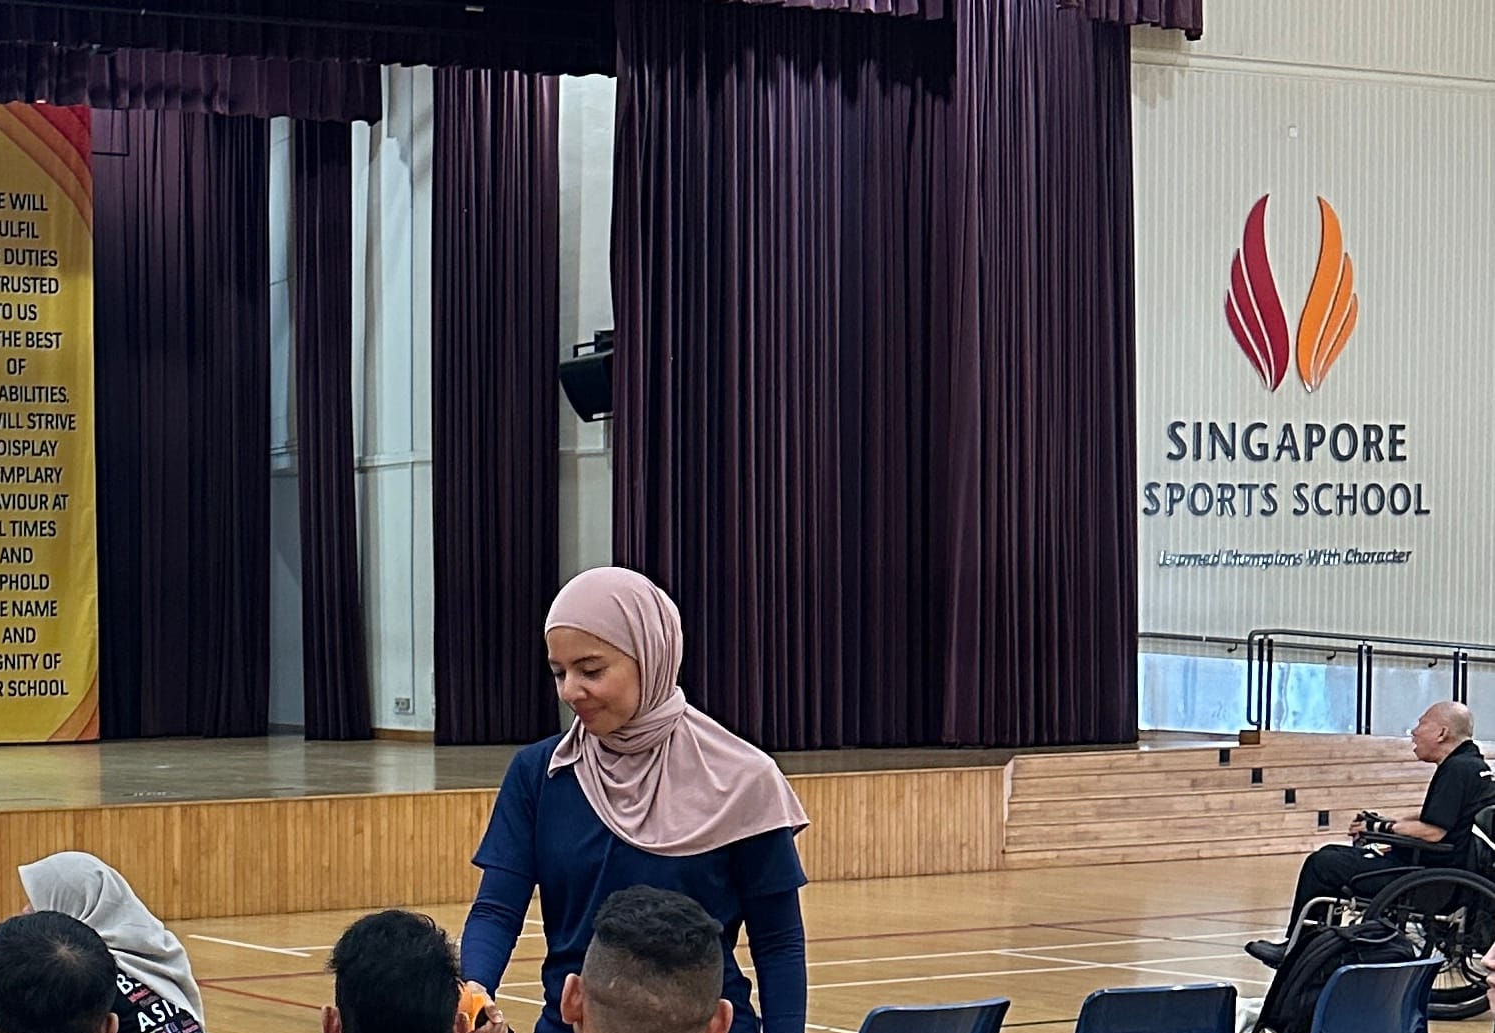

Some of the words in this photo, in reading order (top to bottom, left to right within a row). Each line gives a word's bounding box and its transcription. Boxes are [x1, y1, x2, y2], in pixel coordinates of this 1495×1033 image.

[9, 192, 48, 212] WILL
[4, 247, 58, 267] DUTIES
[17, 304, 38, 321] US
[25, 331, 63, 349] BEST
[7, 357, 27, 375] OF
[27, 413, 76, 431] STRIVE
[1166, 420, 1408, 463] SINGAPORE
[52, 493, 69, 511] AT
[1143, 481, 1278, 518] SPORTS
[1293, 482, 1431, 518] SCHOOL
[9, 520, 57, 538] TIMES
[0, 547, 34, 565] AND
[1221, 549, 1304, 571] Champions
[1305, 549, 1341, 567] With
[1343, 547, 1413, 565] Character
[12, 600, 57, 617] NAME
[2, 627, 36, 644] AND
[42, 653, 61, 670] OF
[7, 679, 69, 697] SCHOOL
